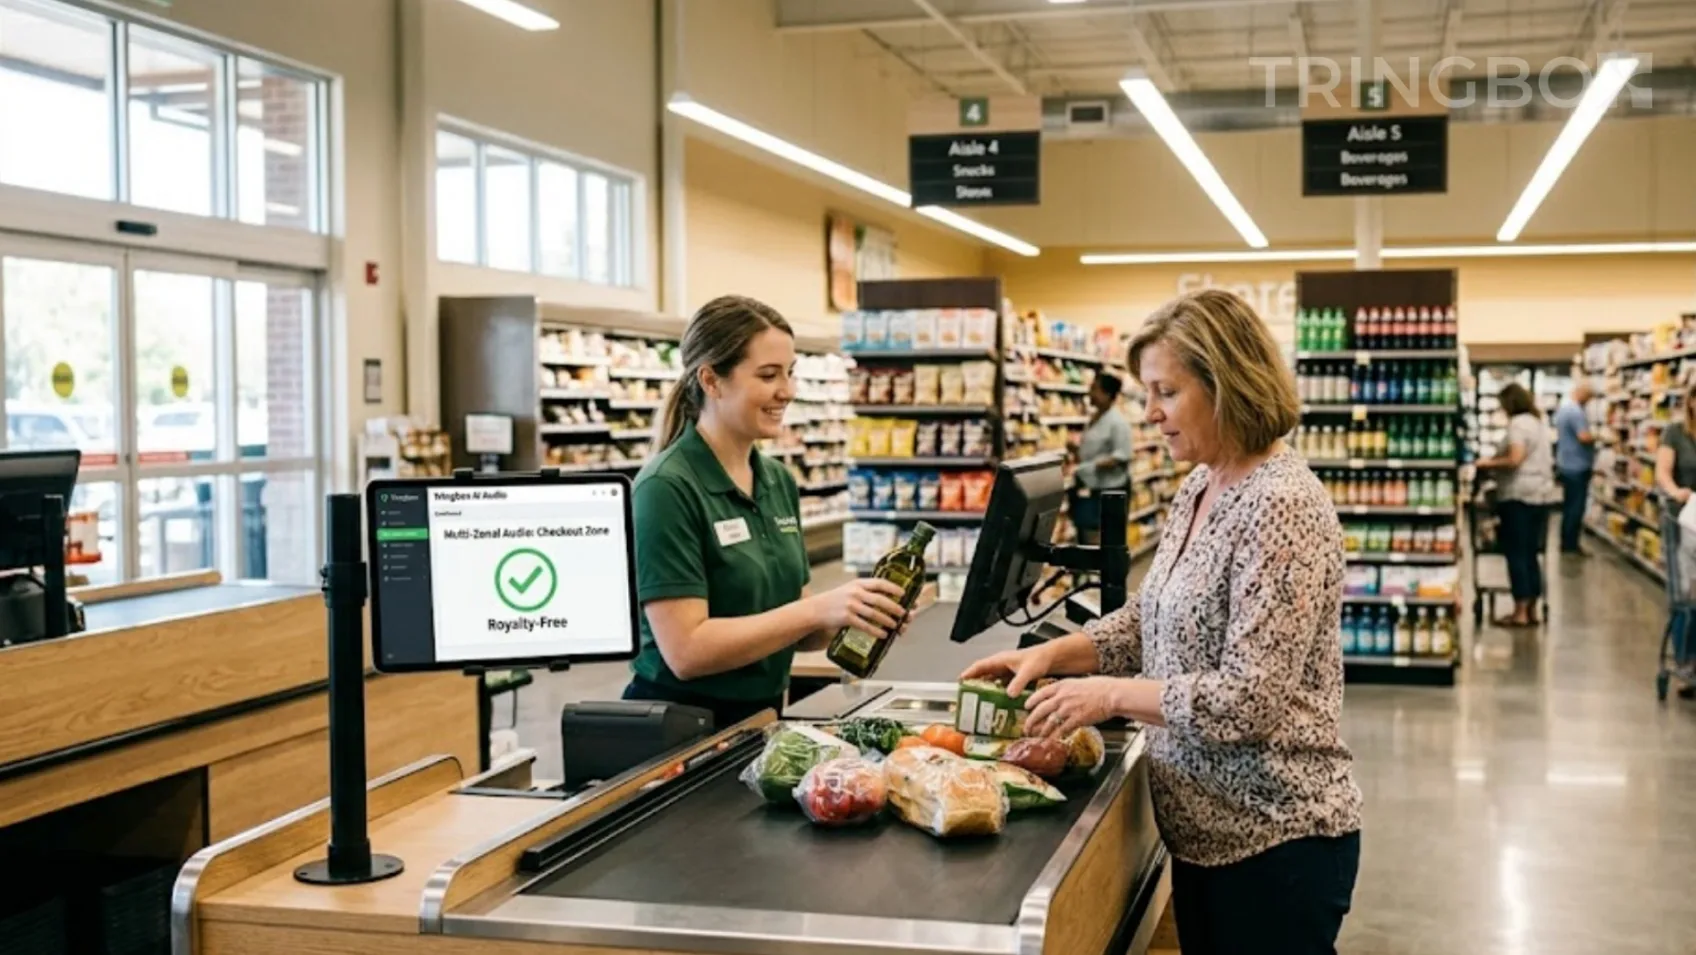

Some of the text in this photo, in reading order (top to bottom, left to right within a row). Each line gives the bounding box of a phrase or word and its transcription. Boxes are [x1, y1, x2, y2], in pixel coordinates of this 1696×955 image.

[966, 104, 981, 121] 4
[1347, 125, 1387, 142] Aisle
[948, 140, 999, 156] Aisle 4
[1341, 150, 1408, 165] Beverages
[1341, 172, 1408, 188] Beverages
[536, 526, 583, 537] Checkout
[585, 525, 609, 536] Zone
[487, 616, 568, 633] Royalty-Free
